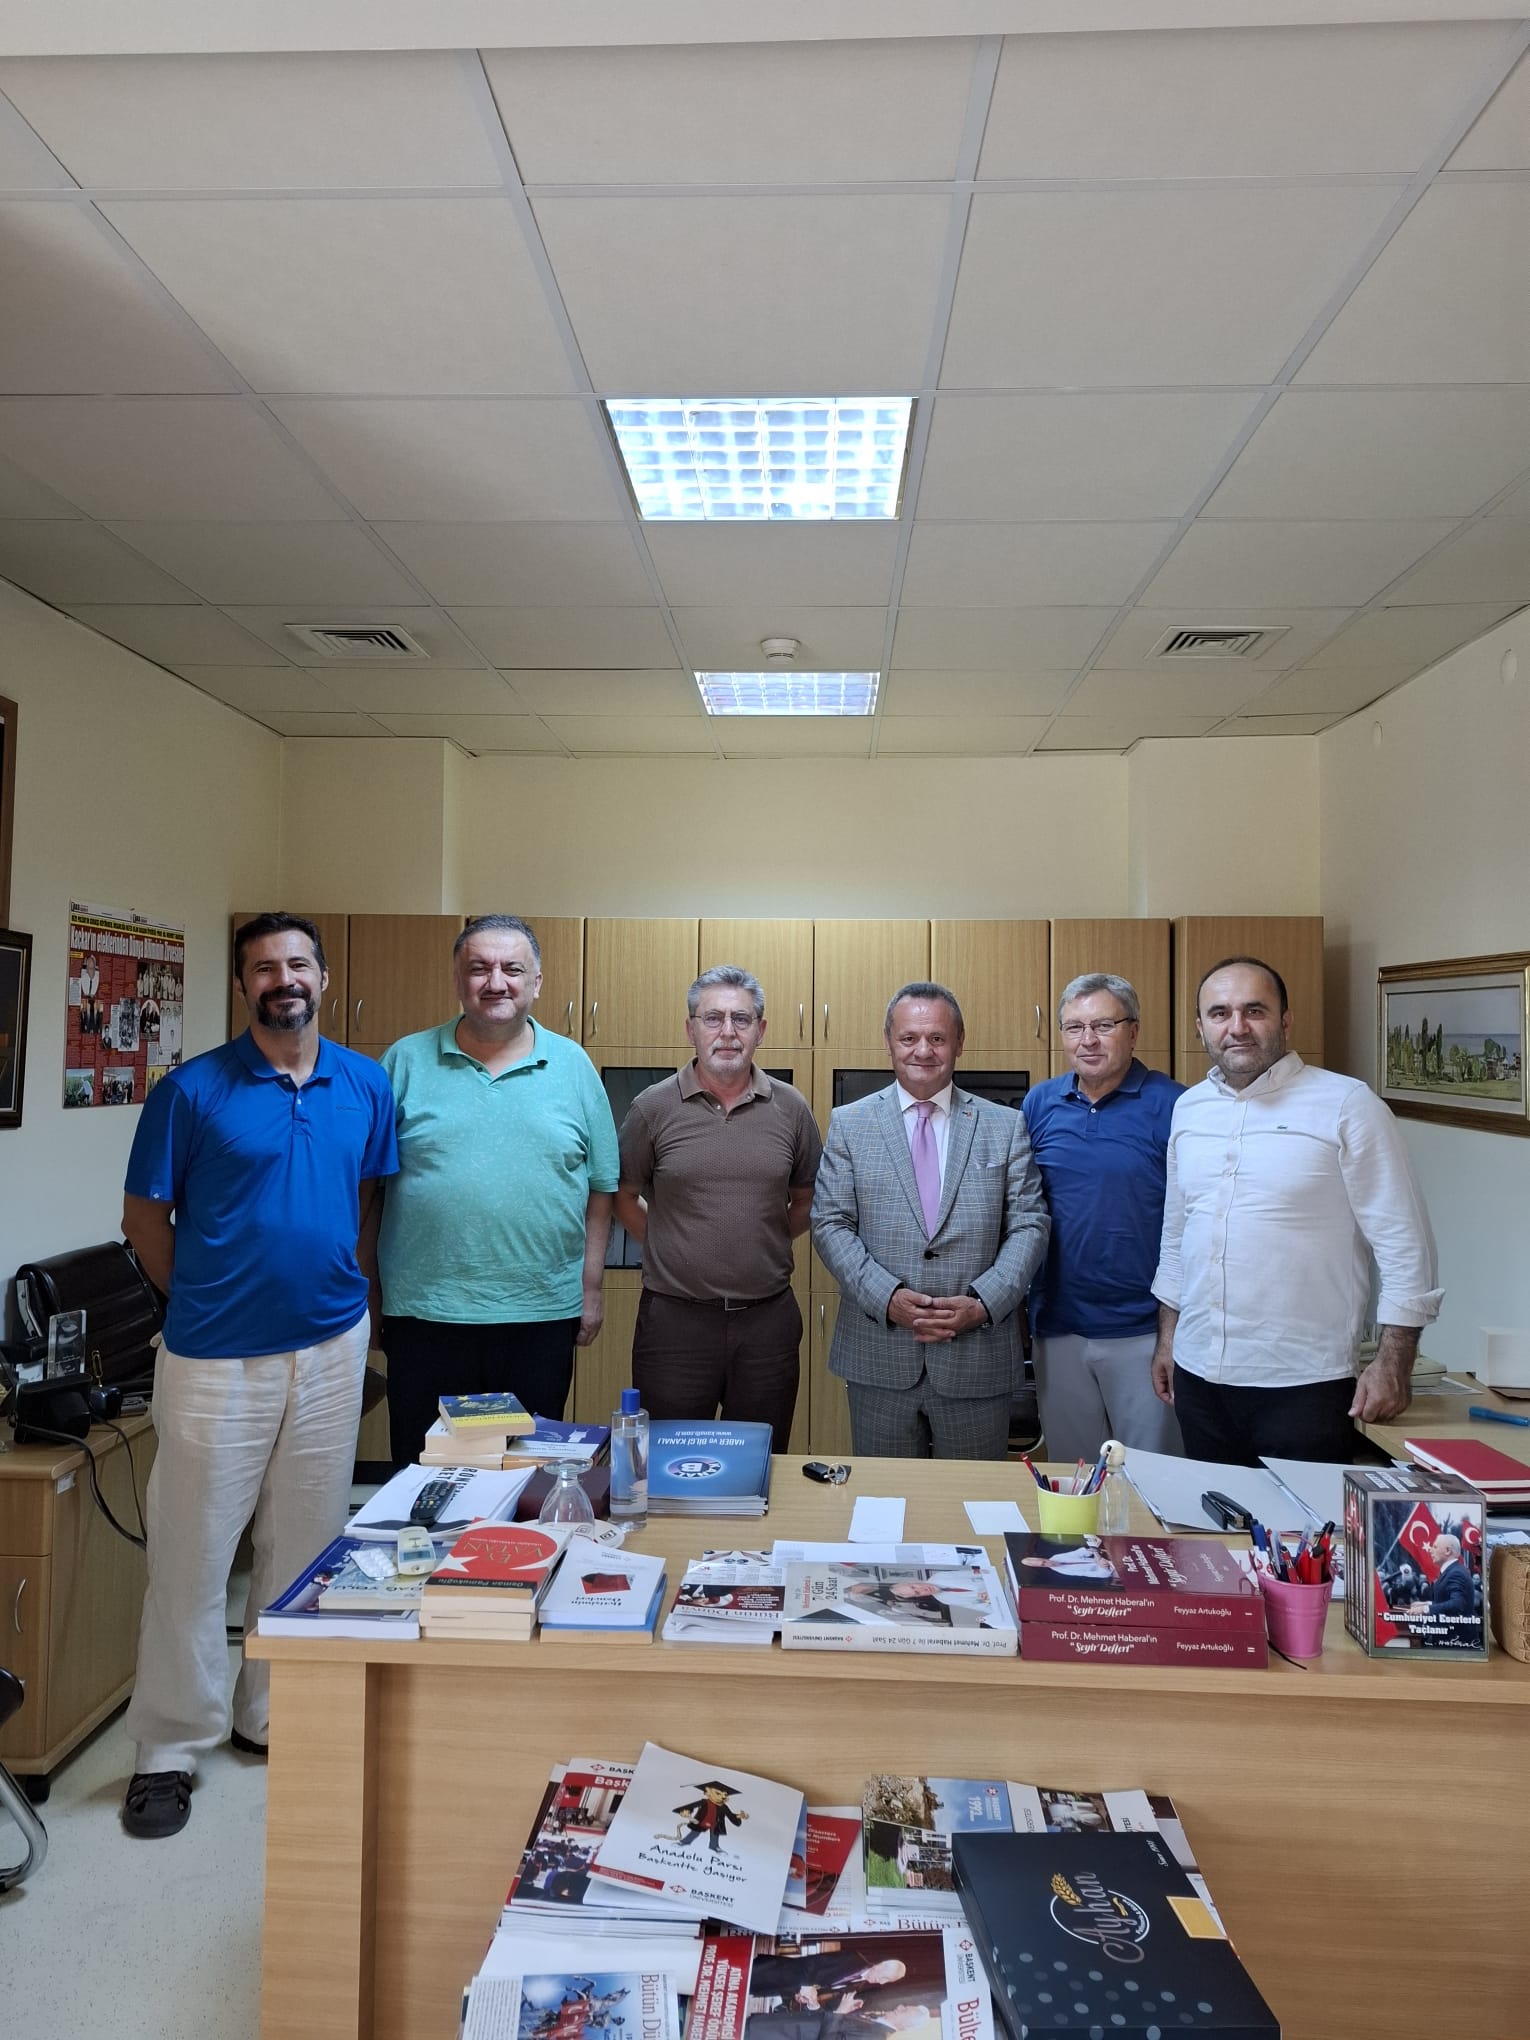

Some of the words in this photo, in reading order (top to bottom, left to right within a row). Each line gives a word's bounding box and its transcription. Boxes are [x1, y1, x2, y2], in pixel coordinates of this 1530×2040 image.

[657, 1437, 687, 1446] KANALI
[719, 1438, 745, 1446] HABER
[1049, 1593, 1066, 1603] Prof.
[1067, 1594, 1079, 1604] Dr.
[1080, 1595, 1114, 1605] Mehmet
[1173, 1605, 1197, 1615] Feyyaz
[1197, 1607, 1232, 1617] Artukoğlu
[1439, 1615, 1481, 1624] Eserlerle
[872, 1636, 887, 1644] Saat
[888, 1636, 897, 1644] 24
[1051, 1630, 1069, 1640] Prof.
[1070, 1631, 1082, 1641] Dr.
[1083, 1632, 1116, 1642] Mehmet
[927, 1638, 952, 1647] Haberal
[953, 1639, 980, 1647] Mehmet
[1176, 1641, 1199, 1651] Feyyaz
[1200, 1642, 1234, 1653] Artukoğlu
[650, 1844, 703, 1863] Anadolu
[710, 1856, 743, 1872] Parsı
[704, 1944, 718, 1965] PROF.
[701, 1965, 713, 1979] DR.
[714, 1959, 730, 1990] YÜKSEK
[728, 1966, 743, 1991] ATİNA
[640, 1973, 660, 2015] Bütün
[695, 1979, 711, 2015] MEHMET
[709, 1990, 724, 2018] ŞEREF
[721, 1992, 739, 2040] AKADEMİSİ
